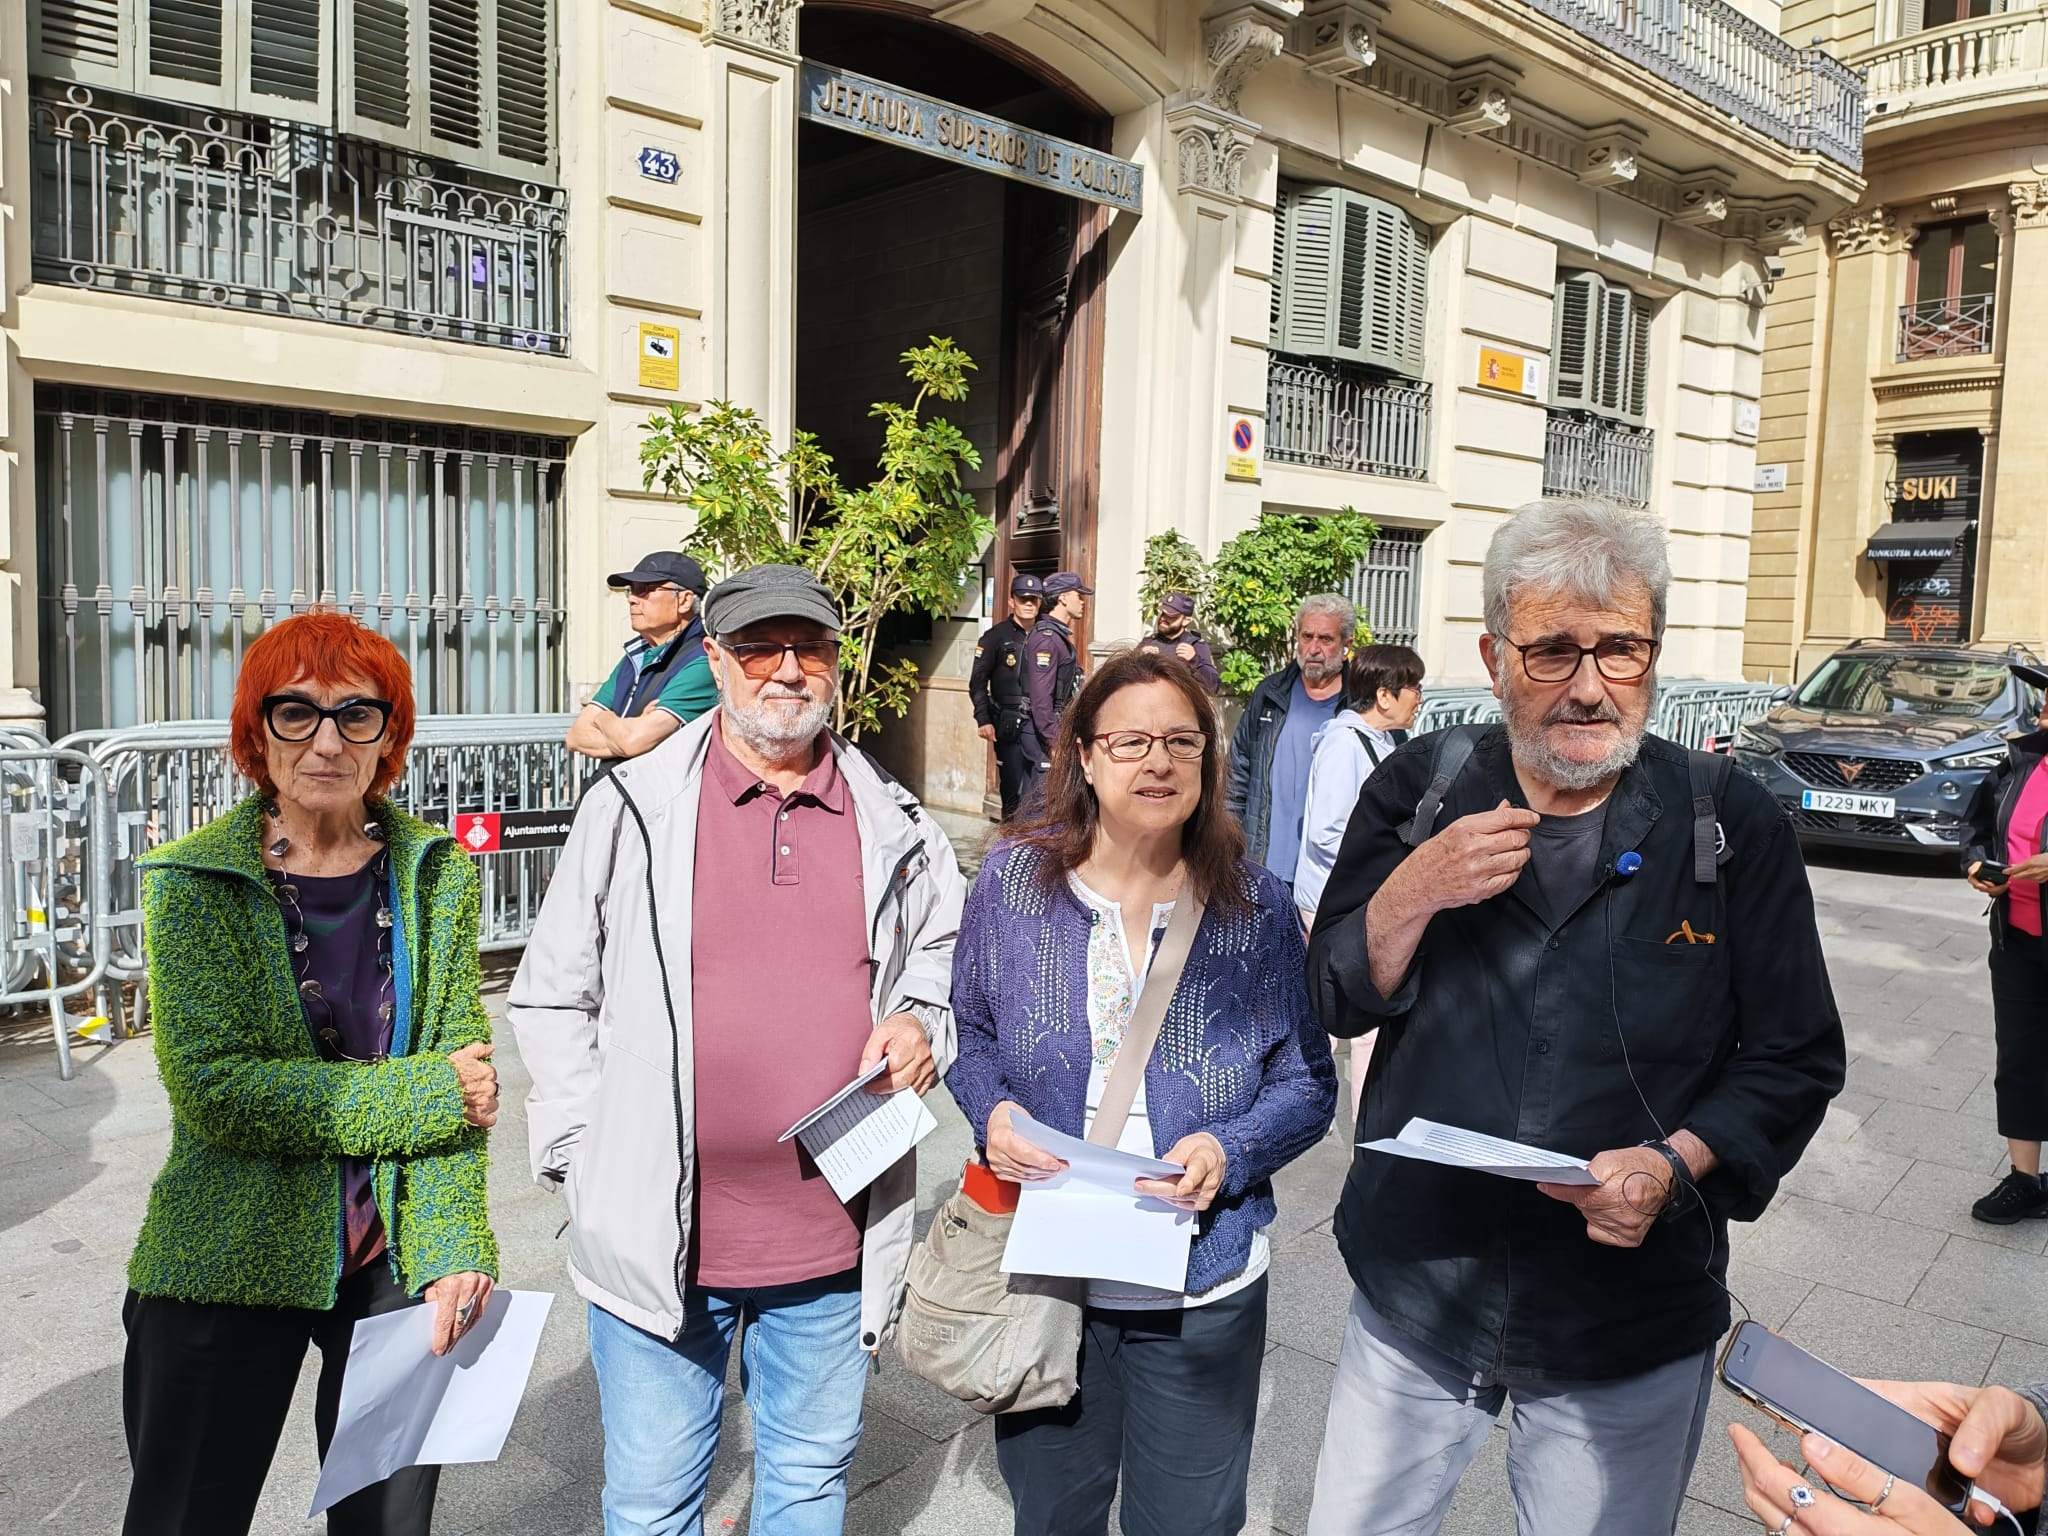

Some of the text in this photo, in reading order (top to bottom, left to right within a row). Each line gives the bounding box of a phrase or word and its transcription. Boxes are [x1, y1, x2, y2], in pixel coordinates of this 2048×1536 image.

[818, 81, 924, 138] JEFATURA
[937, 115, 1027, 169] SUPERIOR
[1037, 143, 1061, 180] DE
[643, 149, 676, 180] 43
[1902, 475, 1957, 501] SUKI
[1913, 548, 1953, 558] RAMEN
[1816, 795, 1889, 814] 1229 MKY
[504, 823, 571, 838] Ajuntament de
